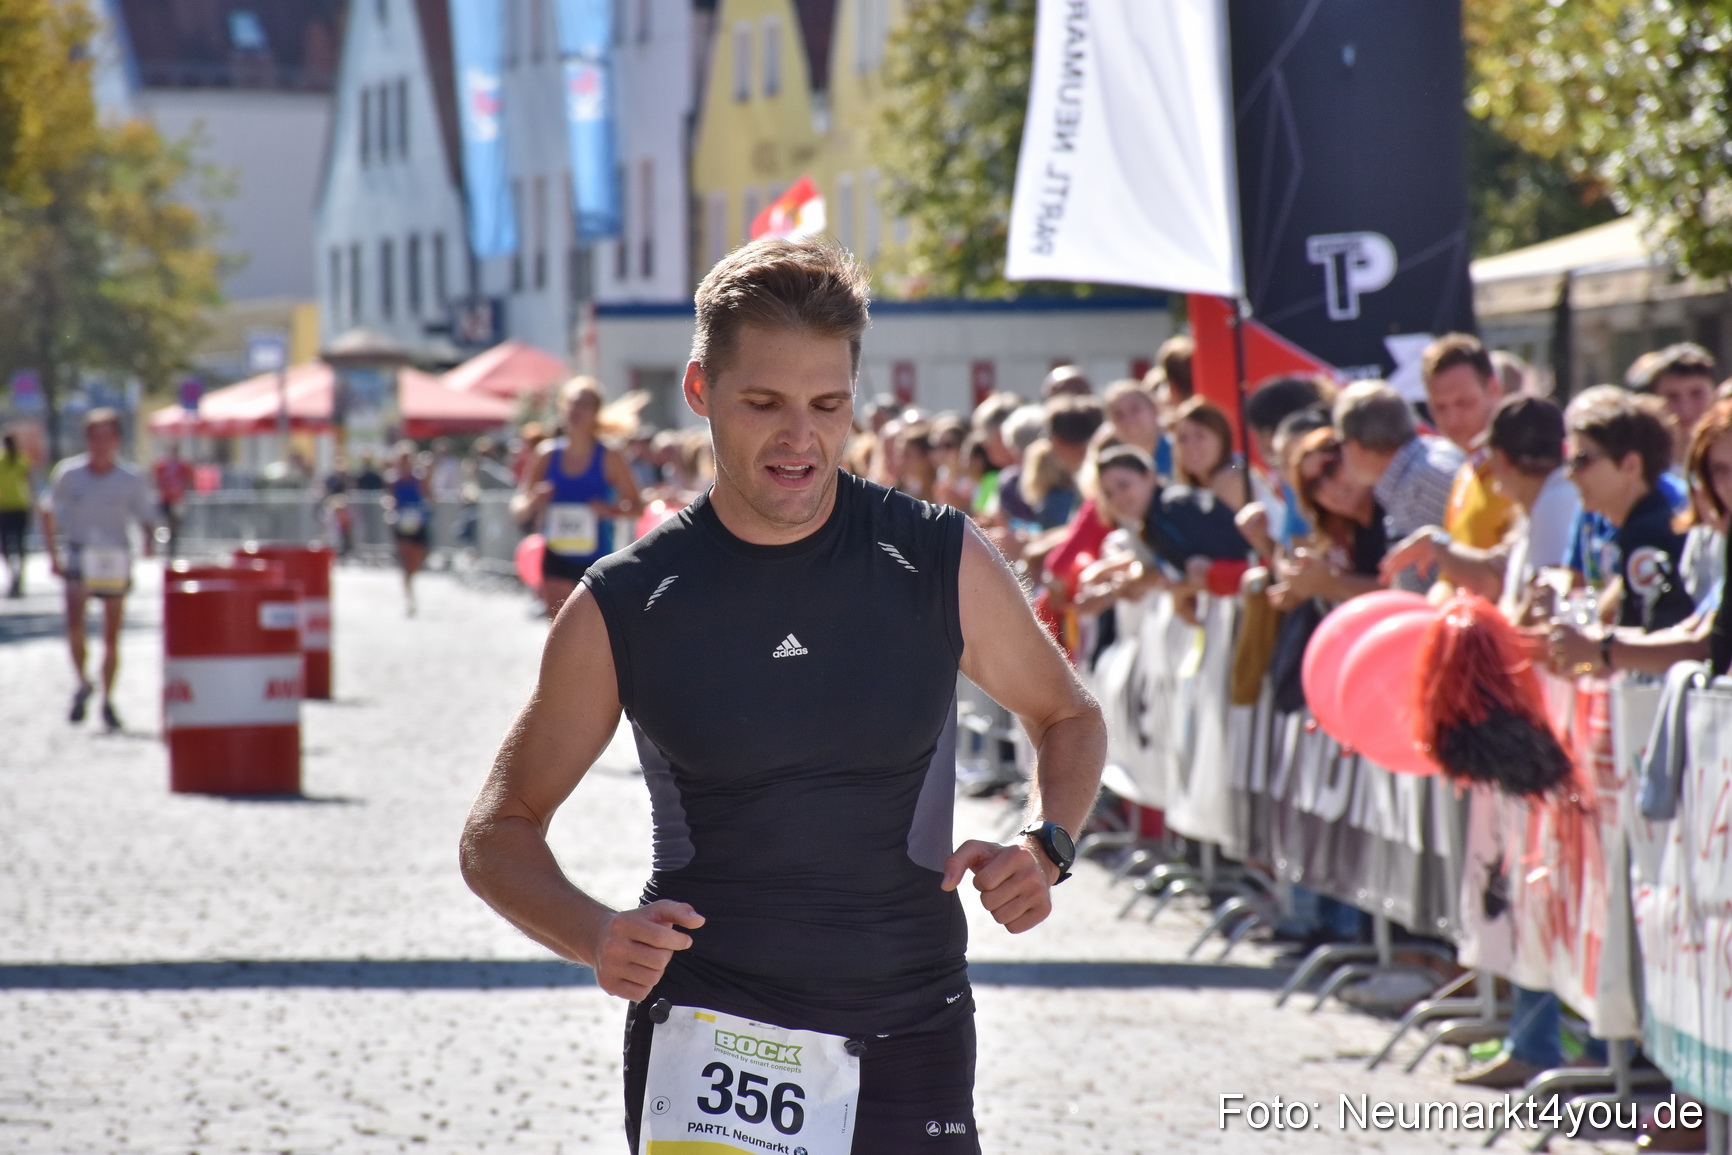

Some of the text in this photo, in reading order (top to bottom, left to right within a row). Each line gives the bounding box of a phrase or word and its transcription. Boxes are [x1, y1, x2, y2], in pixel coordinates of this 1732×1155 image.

[772, 646, 808, 658] adidas
[713, 1046, 802, 1073] inspired by smart concepts
[715, 1029, 802, 1066] BOCK
[697, 1061, 806, 1135] 356
[687, 1122, 790, 1155] PARTL Neumarkt
[944, 1122, 967, 1134] JAKO
